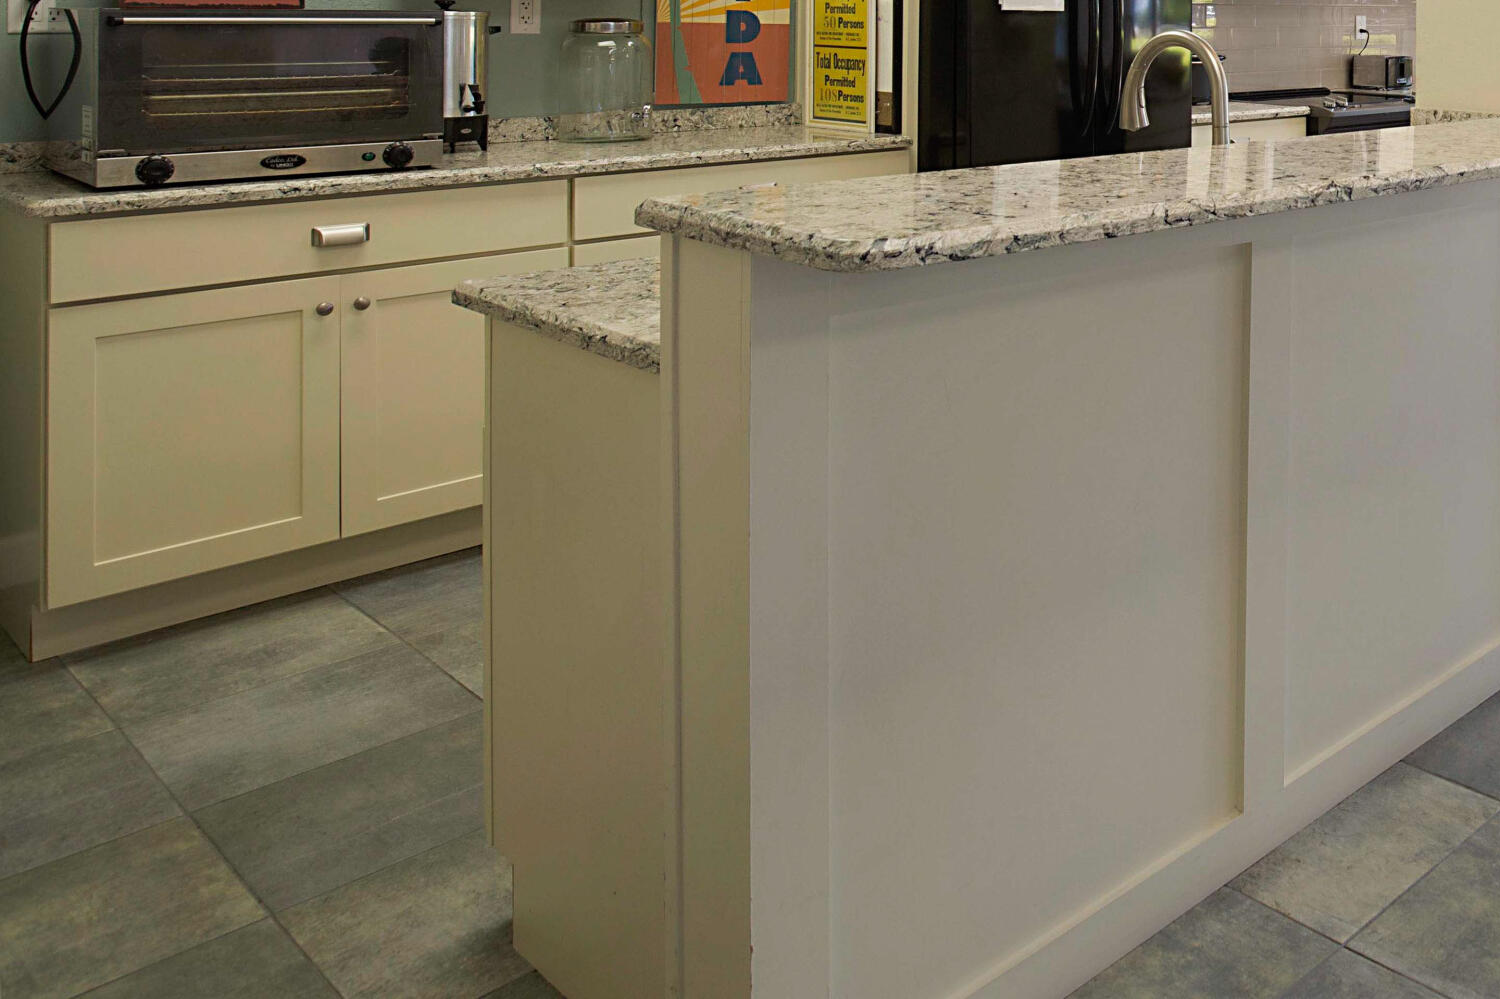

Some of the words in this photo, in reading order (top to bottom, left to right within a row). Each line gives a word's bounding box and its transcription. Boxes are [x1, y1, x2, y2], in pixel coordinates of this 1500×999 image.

[824, 2, 856, 14] Permitted
[823, 16, 836, 29] 50
[838, 17, 865, 29] Persons
[816, 51, 831, 69] Total
[833, 52, 866, 77] Occupancy
[824, 74, 856, 88] Permitted
[837, 89, 865, 103] Persons
